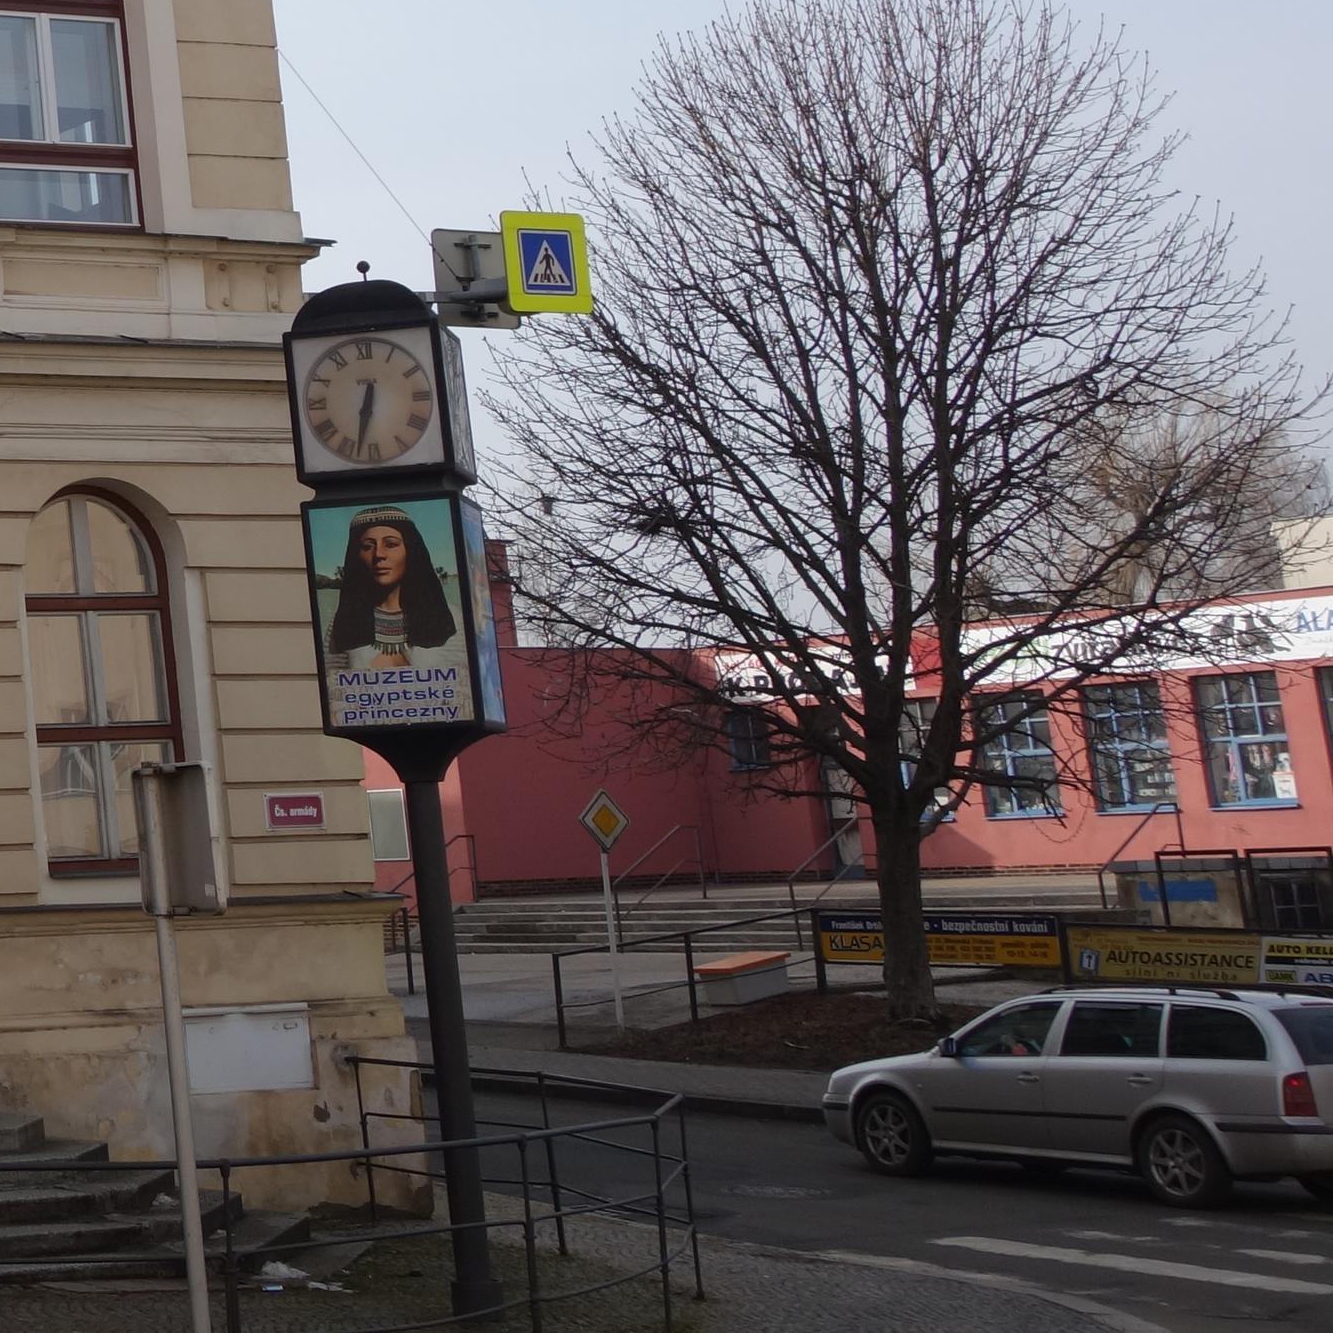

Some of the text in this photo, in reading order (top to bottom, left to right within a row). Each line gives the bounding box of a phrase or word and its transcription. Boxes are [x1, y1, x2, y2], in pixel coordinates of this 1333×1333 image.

[338, 667, 457, 686] MUZEUM
[345, 685, 454, 707] egyptské
[344, 705, 458, 723] princezny
[274, 804, 317, 818] Čs. armády
[941, 919, 1009, 934] bezpečnostní
[1012, 919, 1048, 932] kování
[1268, 944, 1301, 954] AUTO
[1105, 950, 1255, 969] AUTOASSISTANCE
